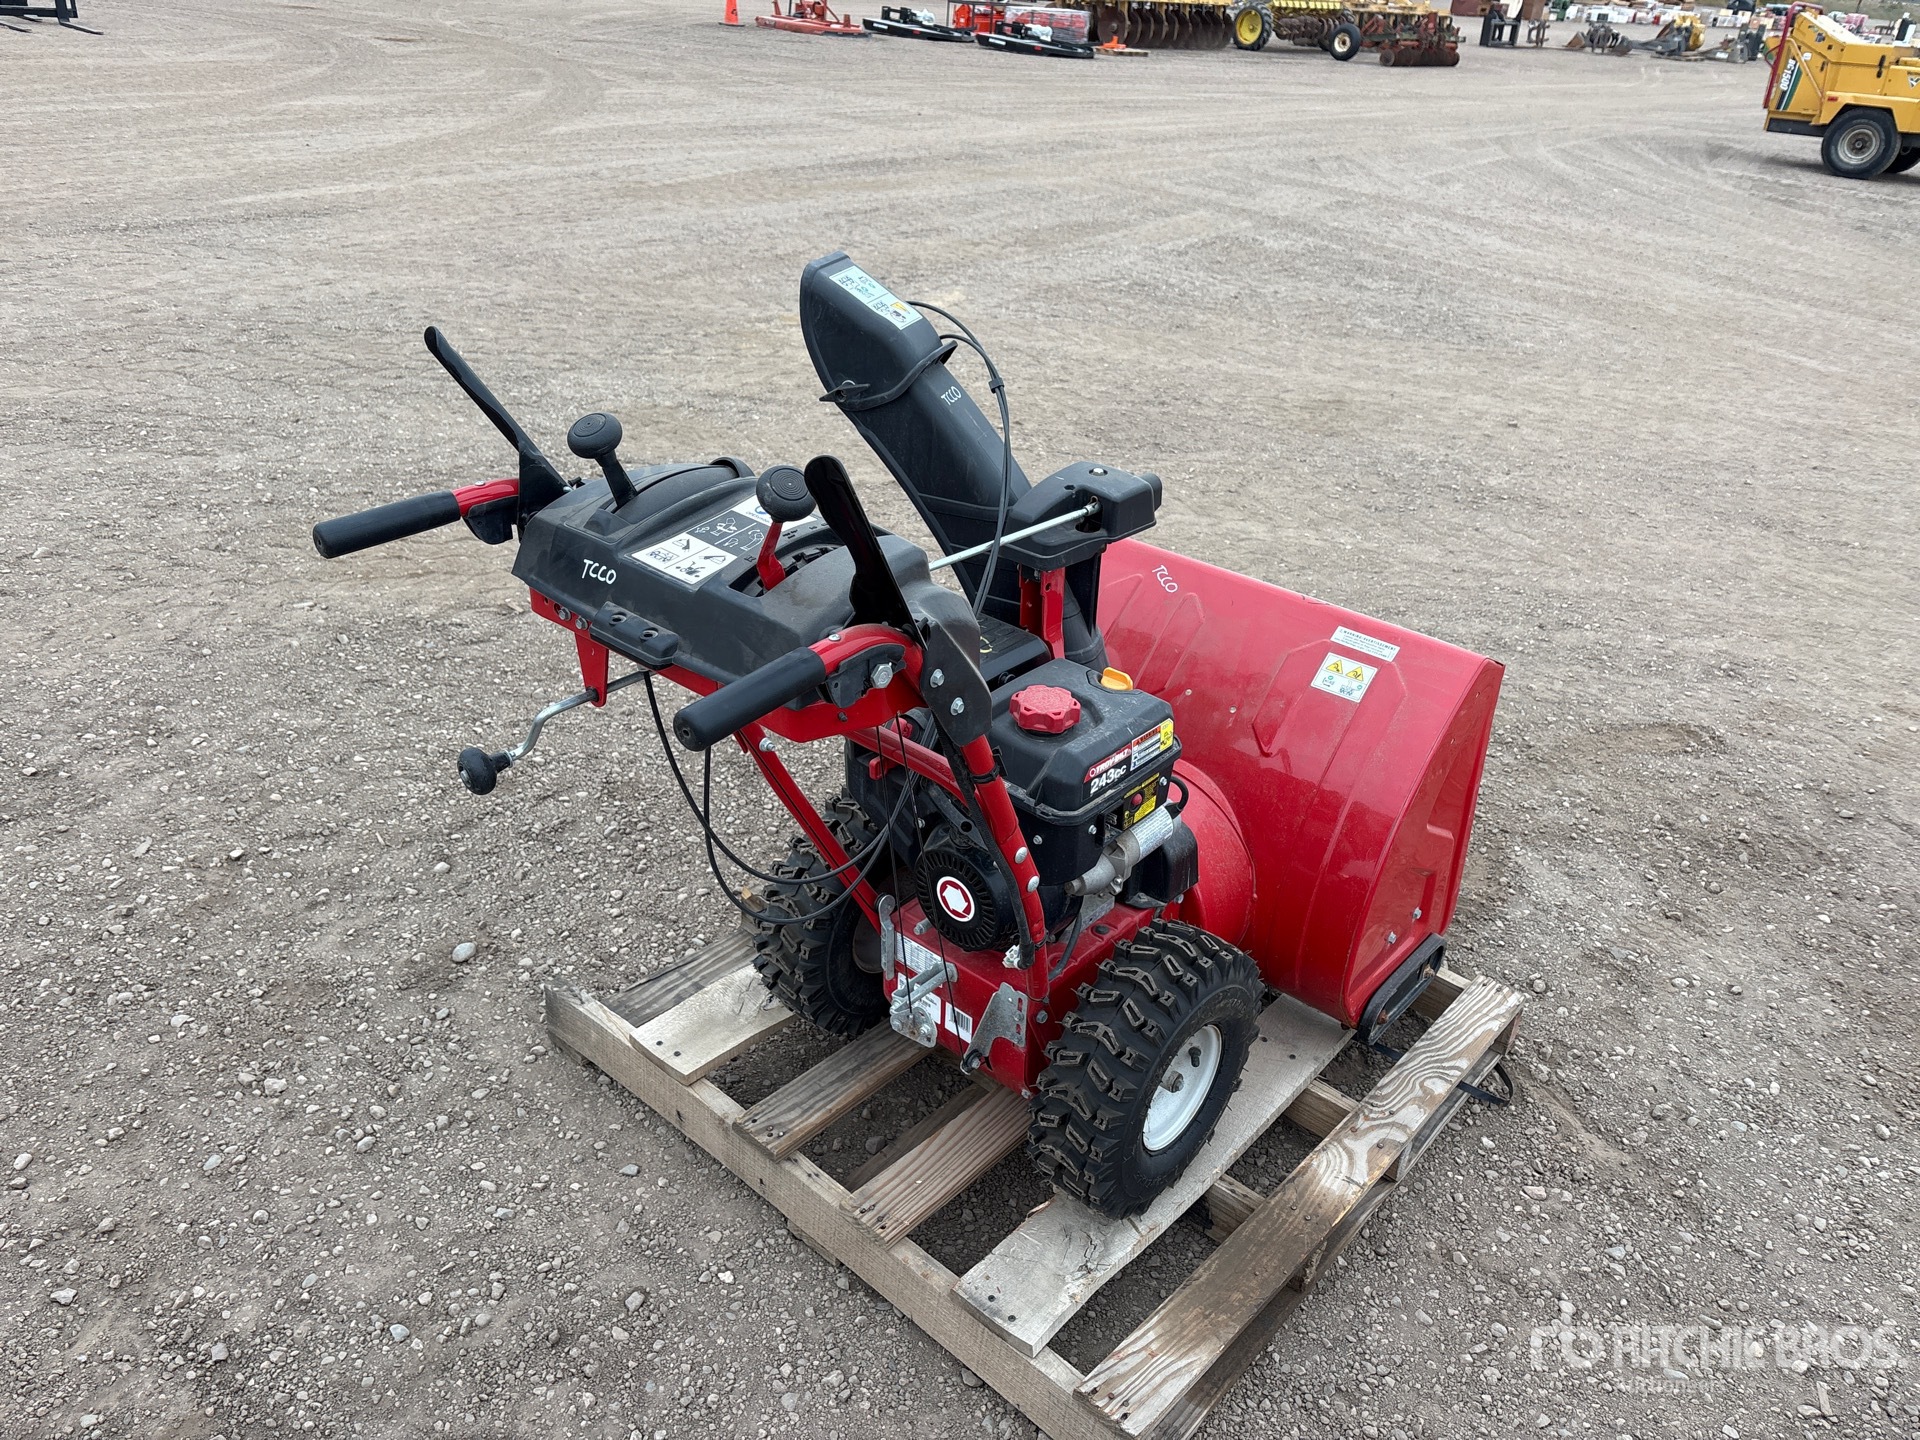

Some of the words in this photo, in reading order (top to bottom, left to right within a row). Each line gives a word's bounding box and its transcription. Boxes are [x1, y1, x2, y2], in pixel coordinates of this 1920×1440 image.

[940, 386, 962, 406] TCCO
[581, 558, 617, 585] TCCO
[1151, 564, 1179, 593] TCCO
